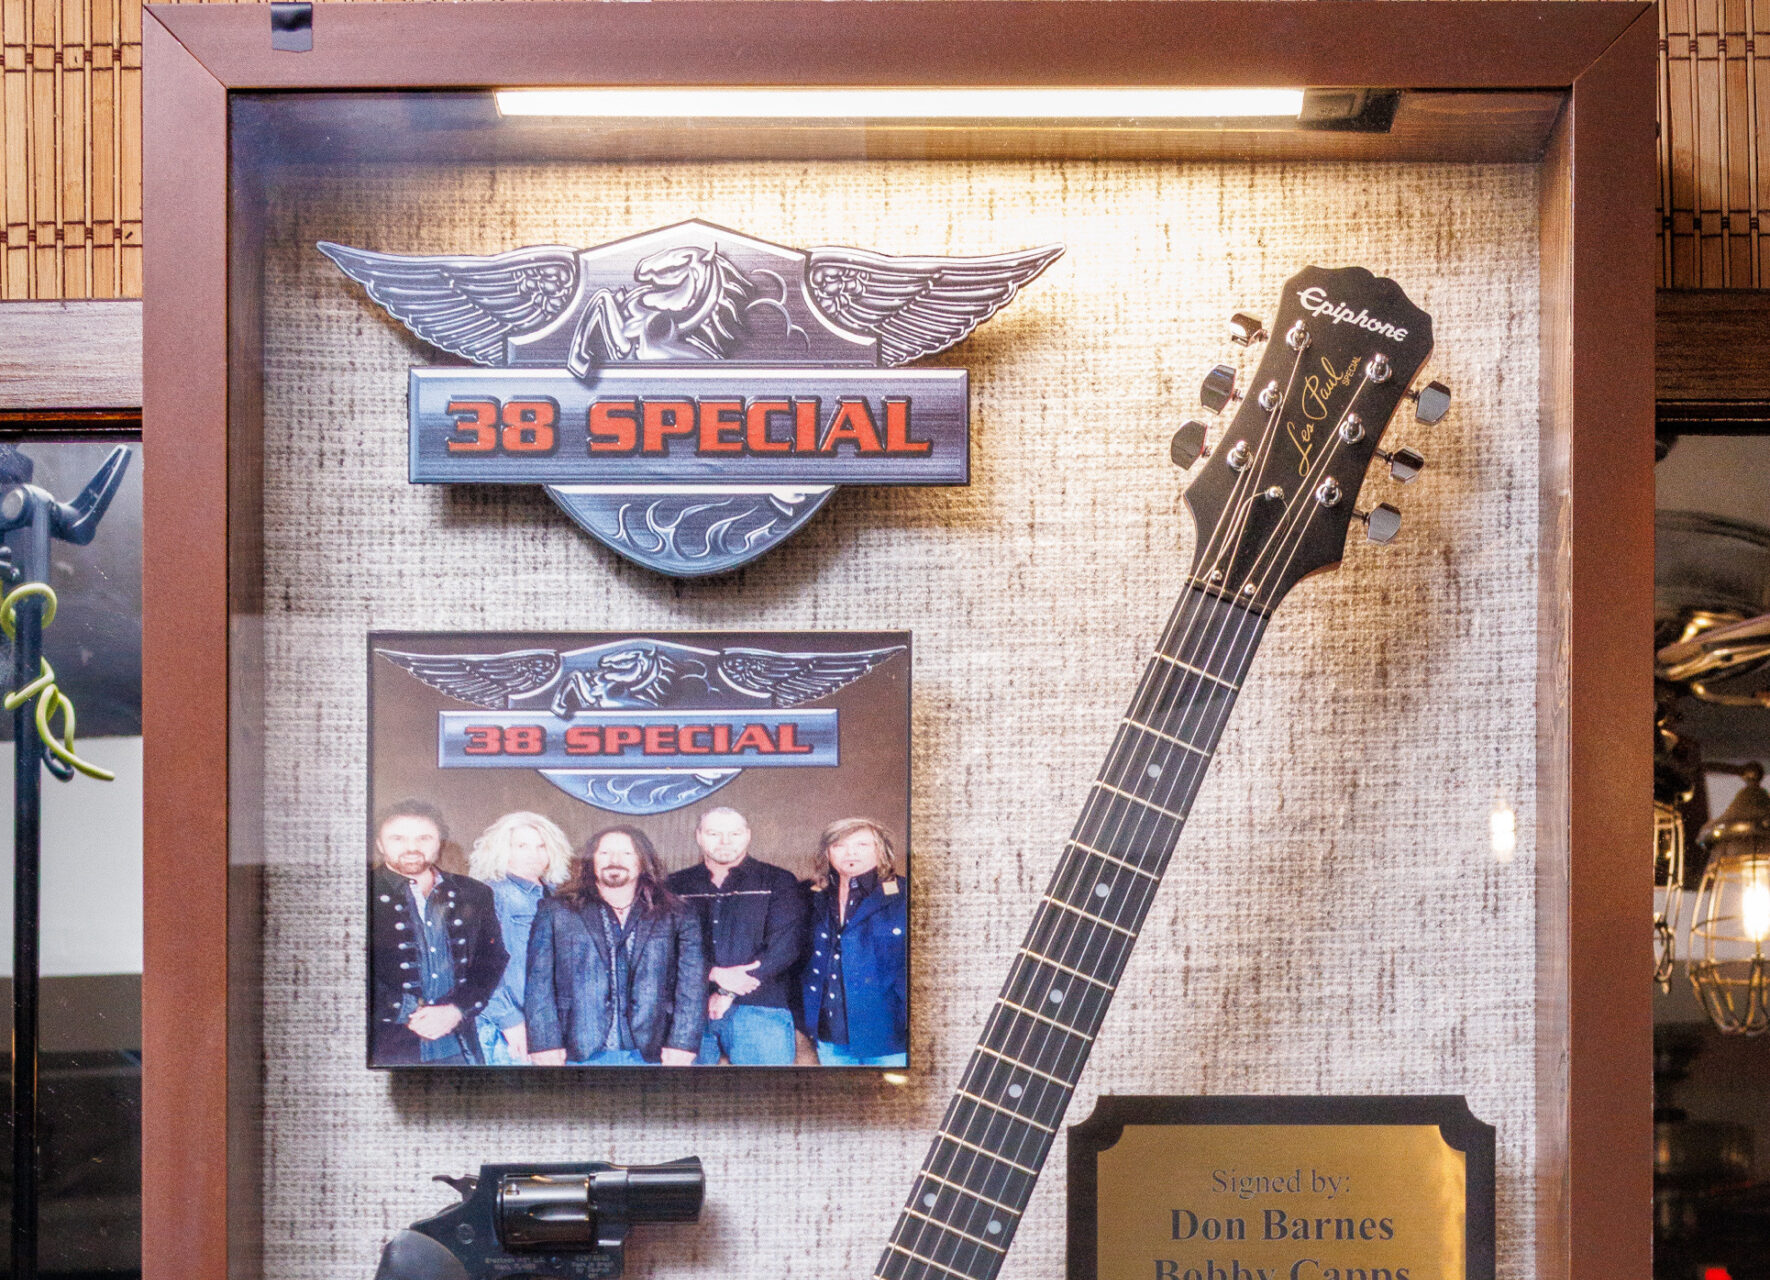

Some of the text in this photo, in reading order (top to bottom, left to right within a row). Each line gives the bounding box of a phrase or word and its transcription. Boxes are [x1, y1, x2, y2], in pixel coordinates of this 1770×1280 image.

[1297, 286, 1408, 342] Epiphone
[1342, 356, 1362, 386] SPECIAL
[1302, 356, 1345, 420] Paul
[445, 396, 934, 455] 38 SPECIAL
[464, 725, 811, 757] 38 SPECIAL
[1212, 1169, 1351, 1199] Signed by:
[1170, 1208, 1395, 1241] Don Barnes
